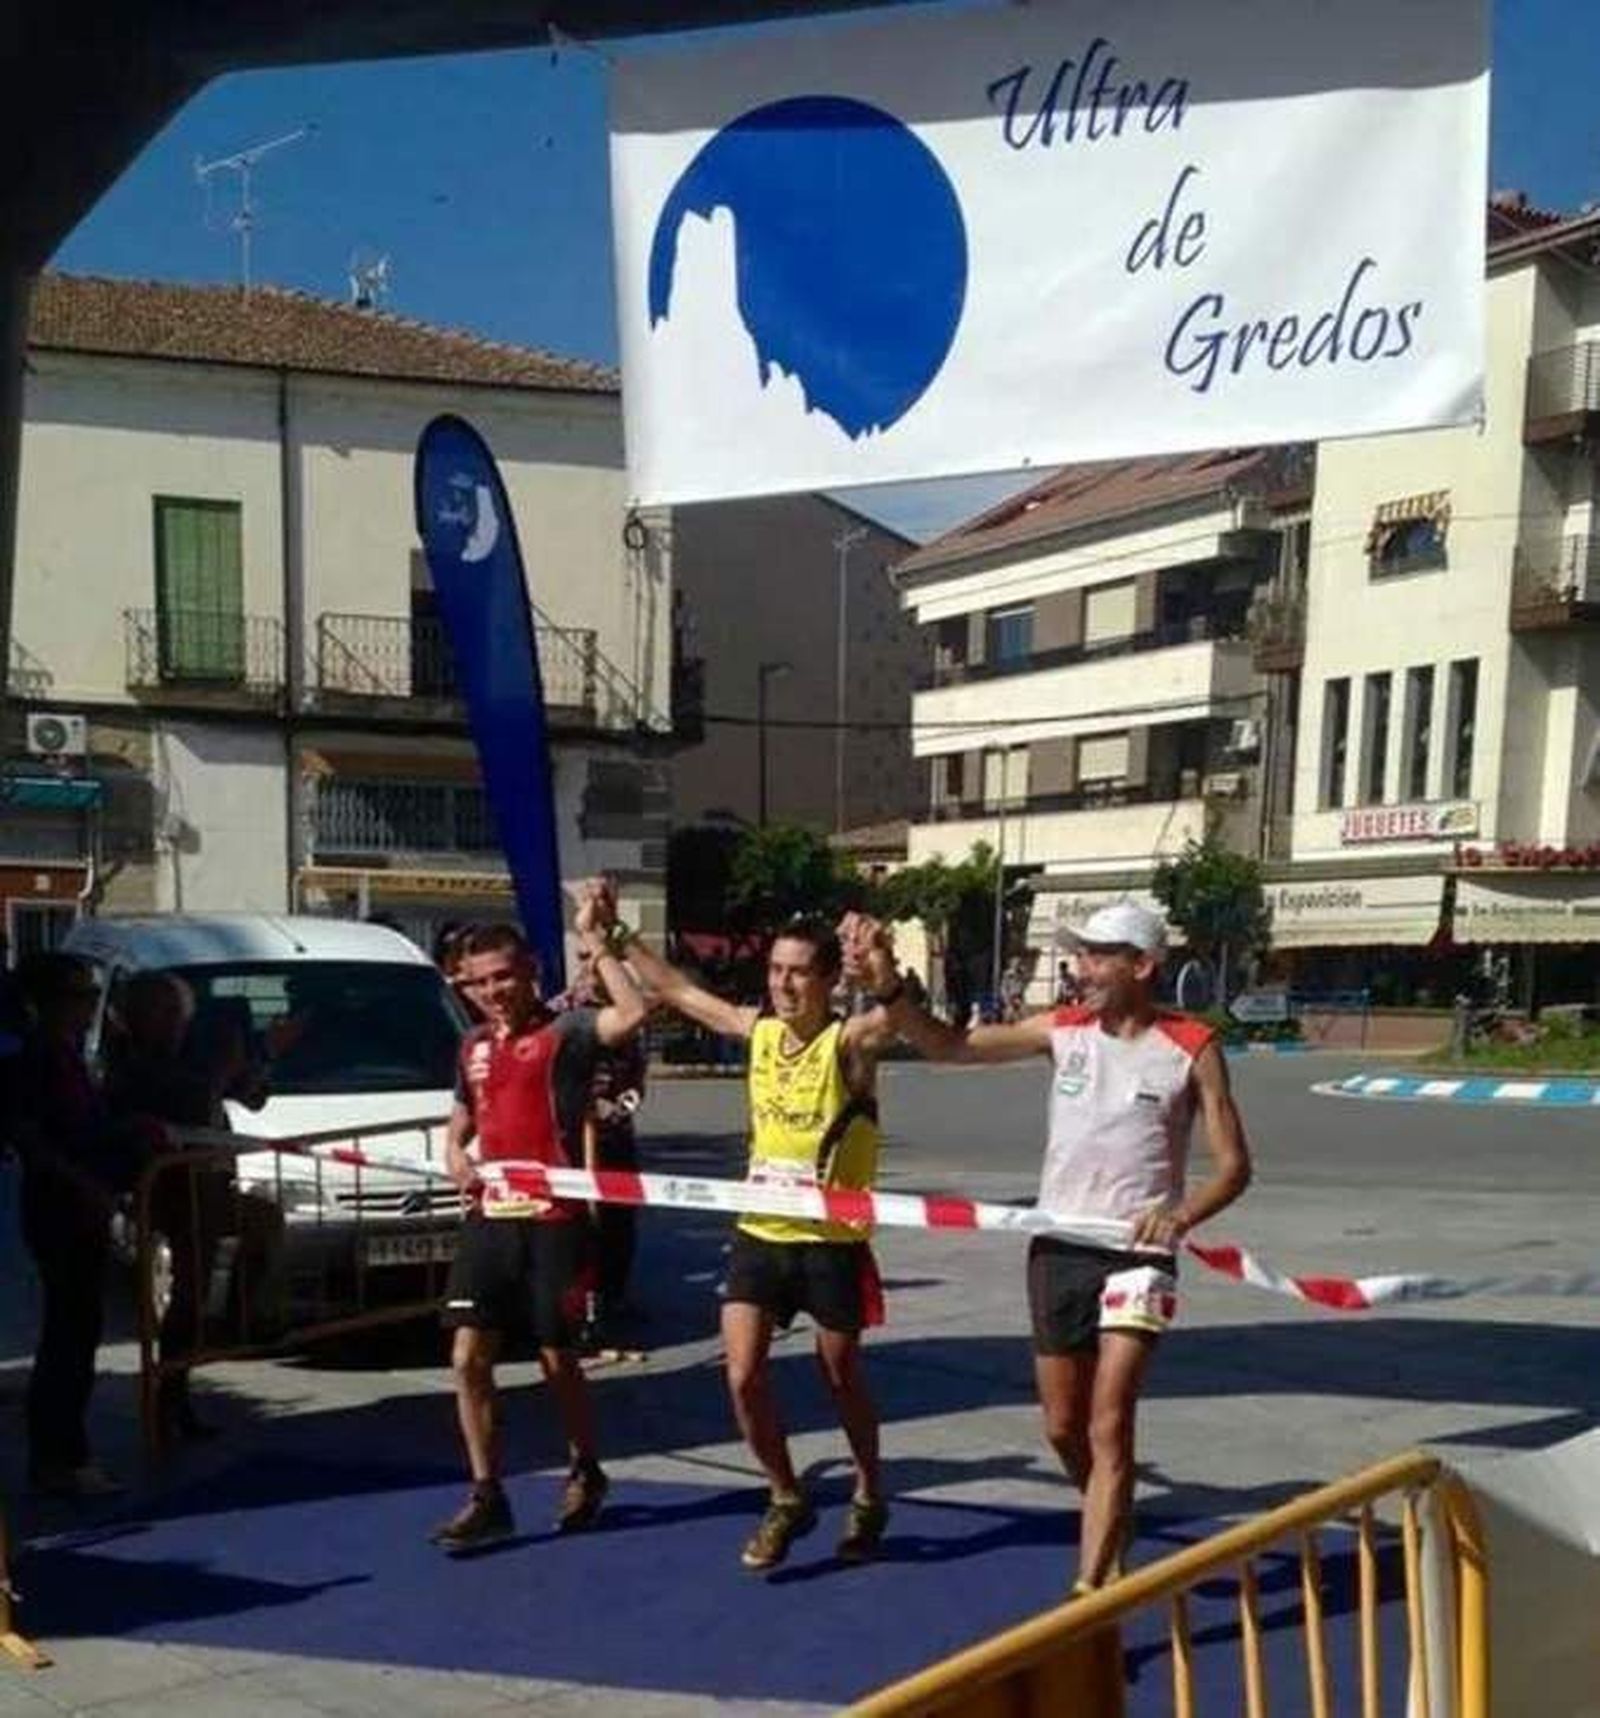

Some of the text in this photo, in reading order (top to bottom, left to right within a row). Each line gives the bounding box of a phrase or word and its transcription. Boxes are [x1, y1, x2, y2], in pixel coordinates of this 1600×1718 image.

[987, 37, 1190, 149] Ultra
[1126, 165, 1206, 274] de
[1165, 257, 1422, 393] Gredos
[1341, 809, 1430, 838] JUGUETES
